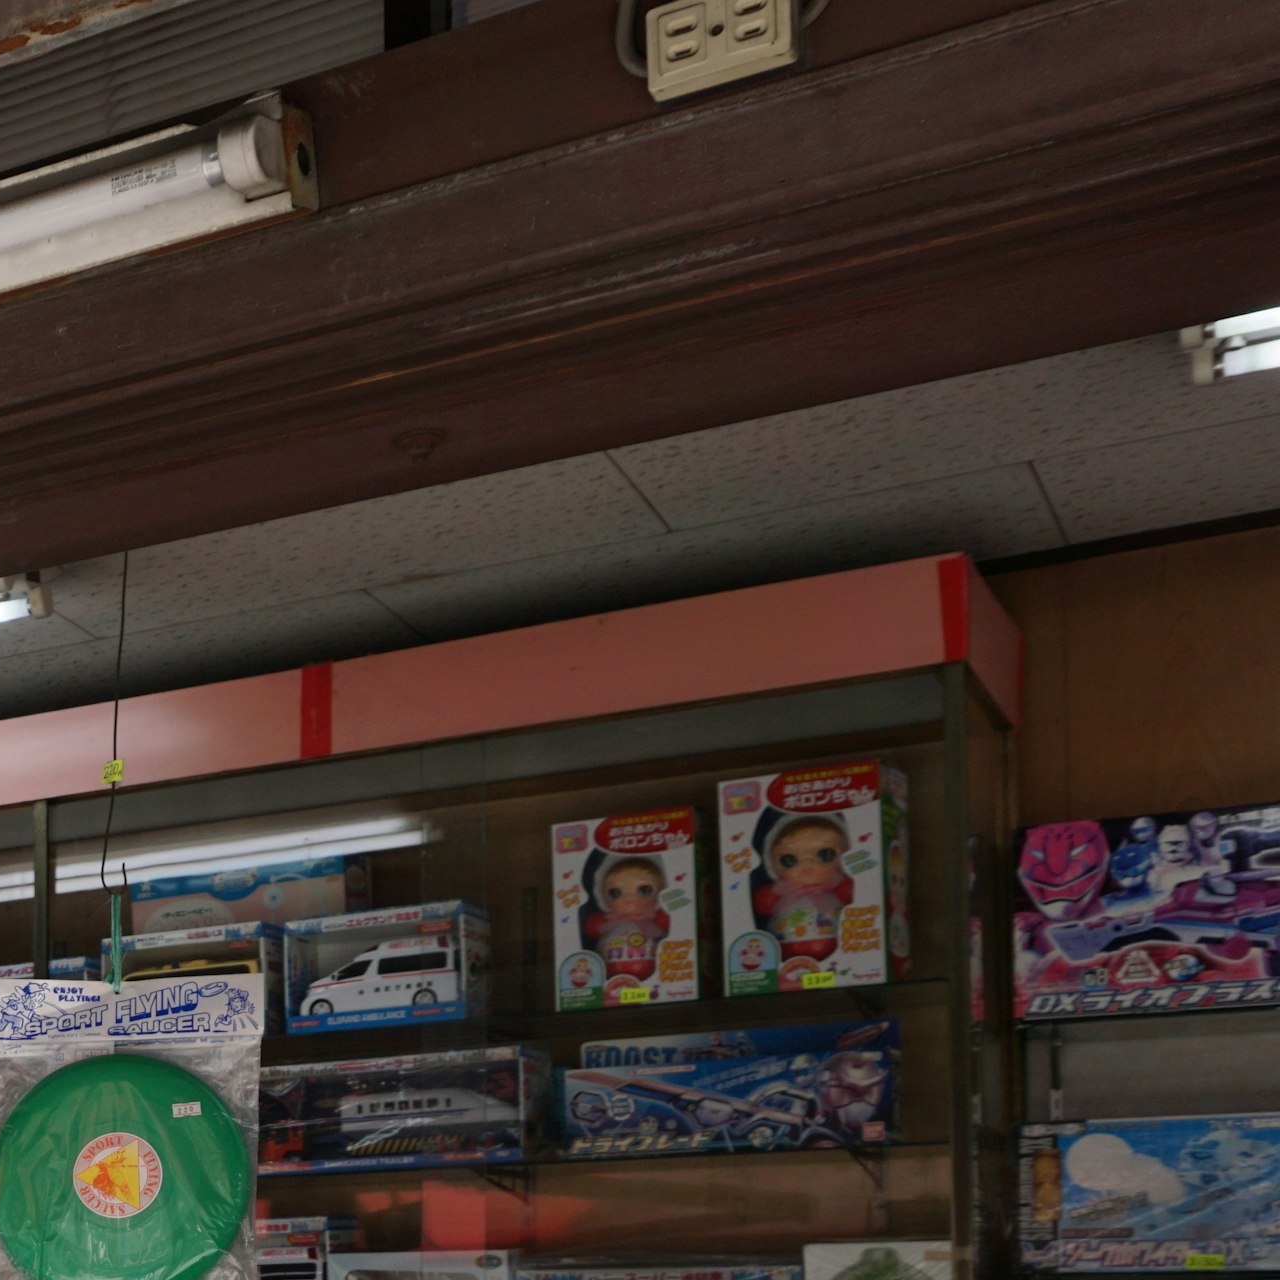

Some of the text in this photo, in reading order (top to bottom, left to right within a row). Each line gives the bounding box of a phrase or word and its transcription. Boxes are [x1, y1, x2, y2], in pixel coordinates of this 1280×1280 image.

[52, 986, 85, 996] ENJOY
[57, 994, 101, 1003] PLAYING!
[25, 981, 211, 1038] SPORT FLYING SAUCER
[81, 1136, 126, 1163] SPORT
[141, 1150, 156, 1197] FLYING
[80, 1185, 128, 1216] SAUCER
